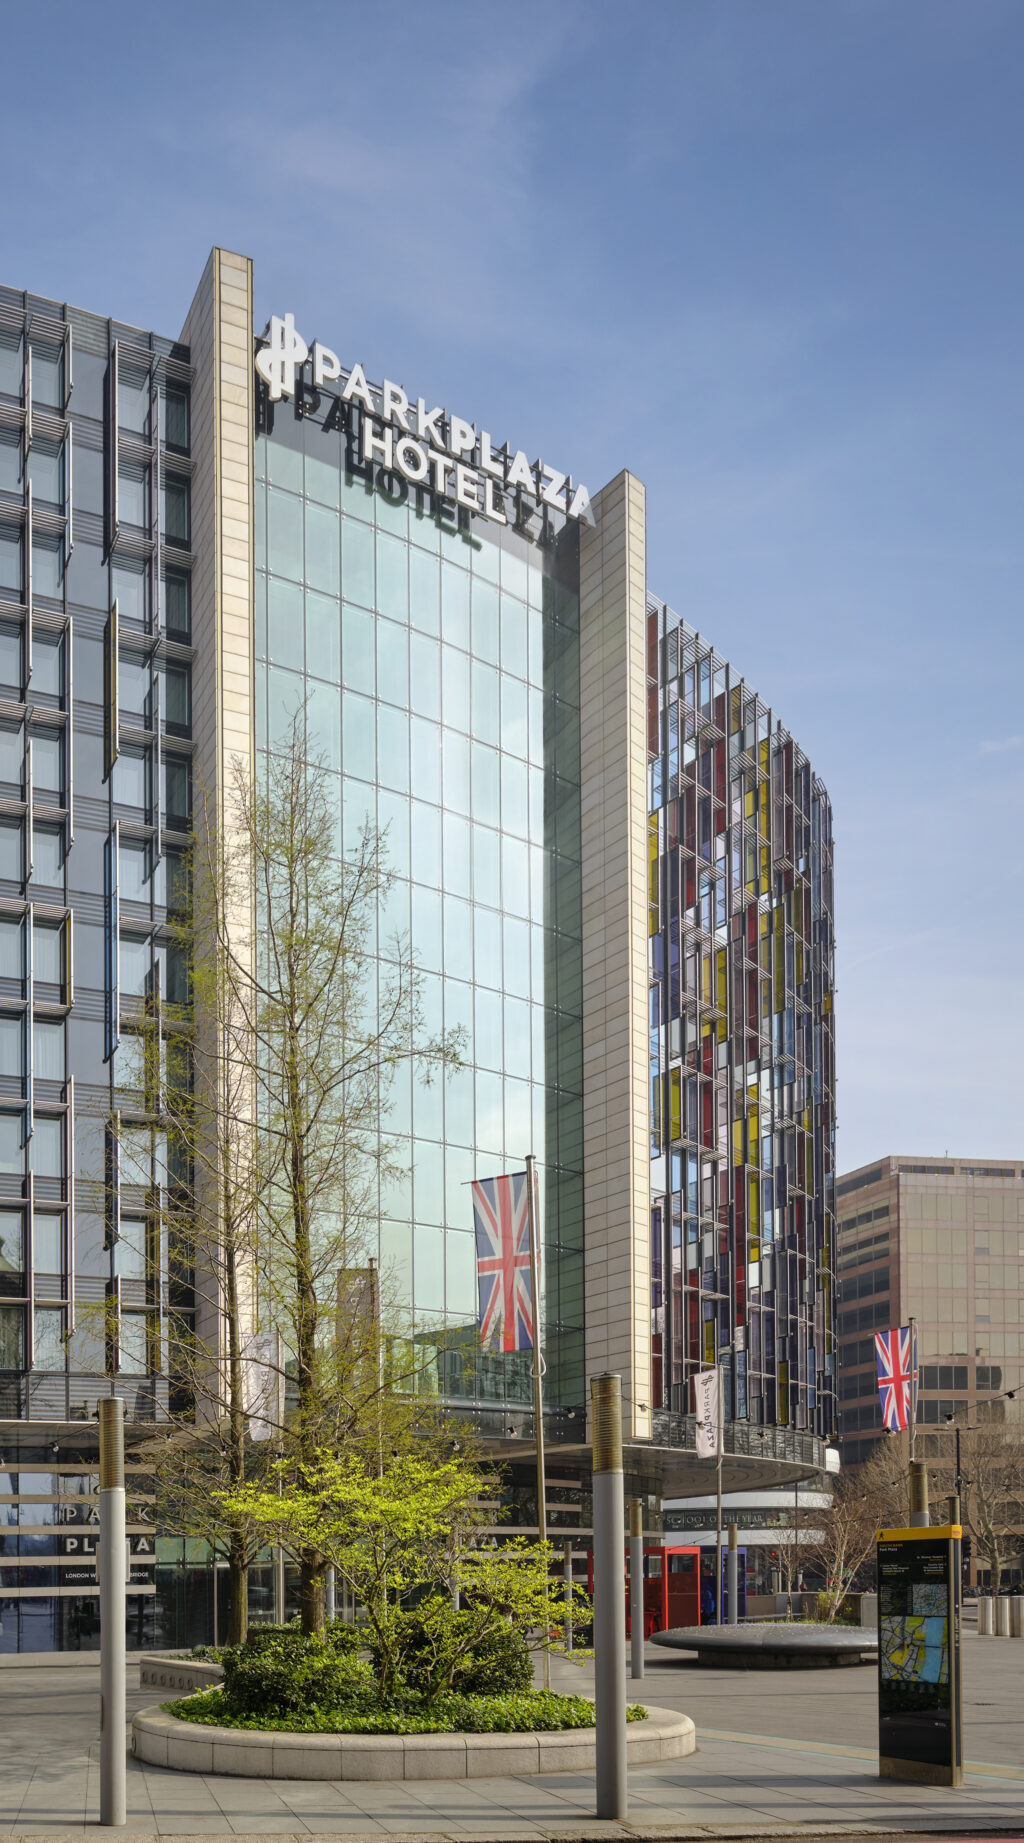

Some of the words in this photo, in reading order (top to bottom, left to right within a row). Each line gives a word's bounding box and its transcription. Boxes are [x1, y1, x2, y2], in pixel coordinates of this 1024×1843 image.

[363, 416, 507, 526] HOTEL
[66, 1506, 150, 1521] PAK
[66, 1537, 150, 1552] PLA
